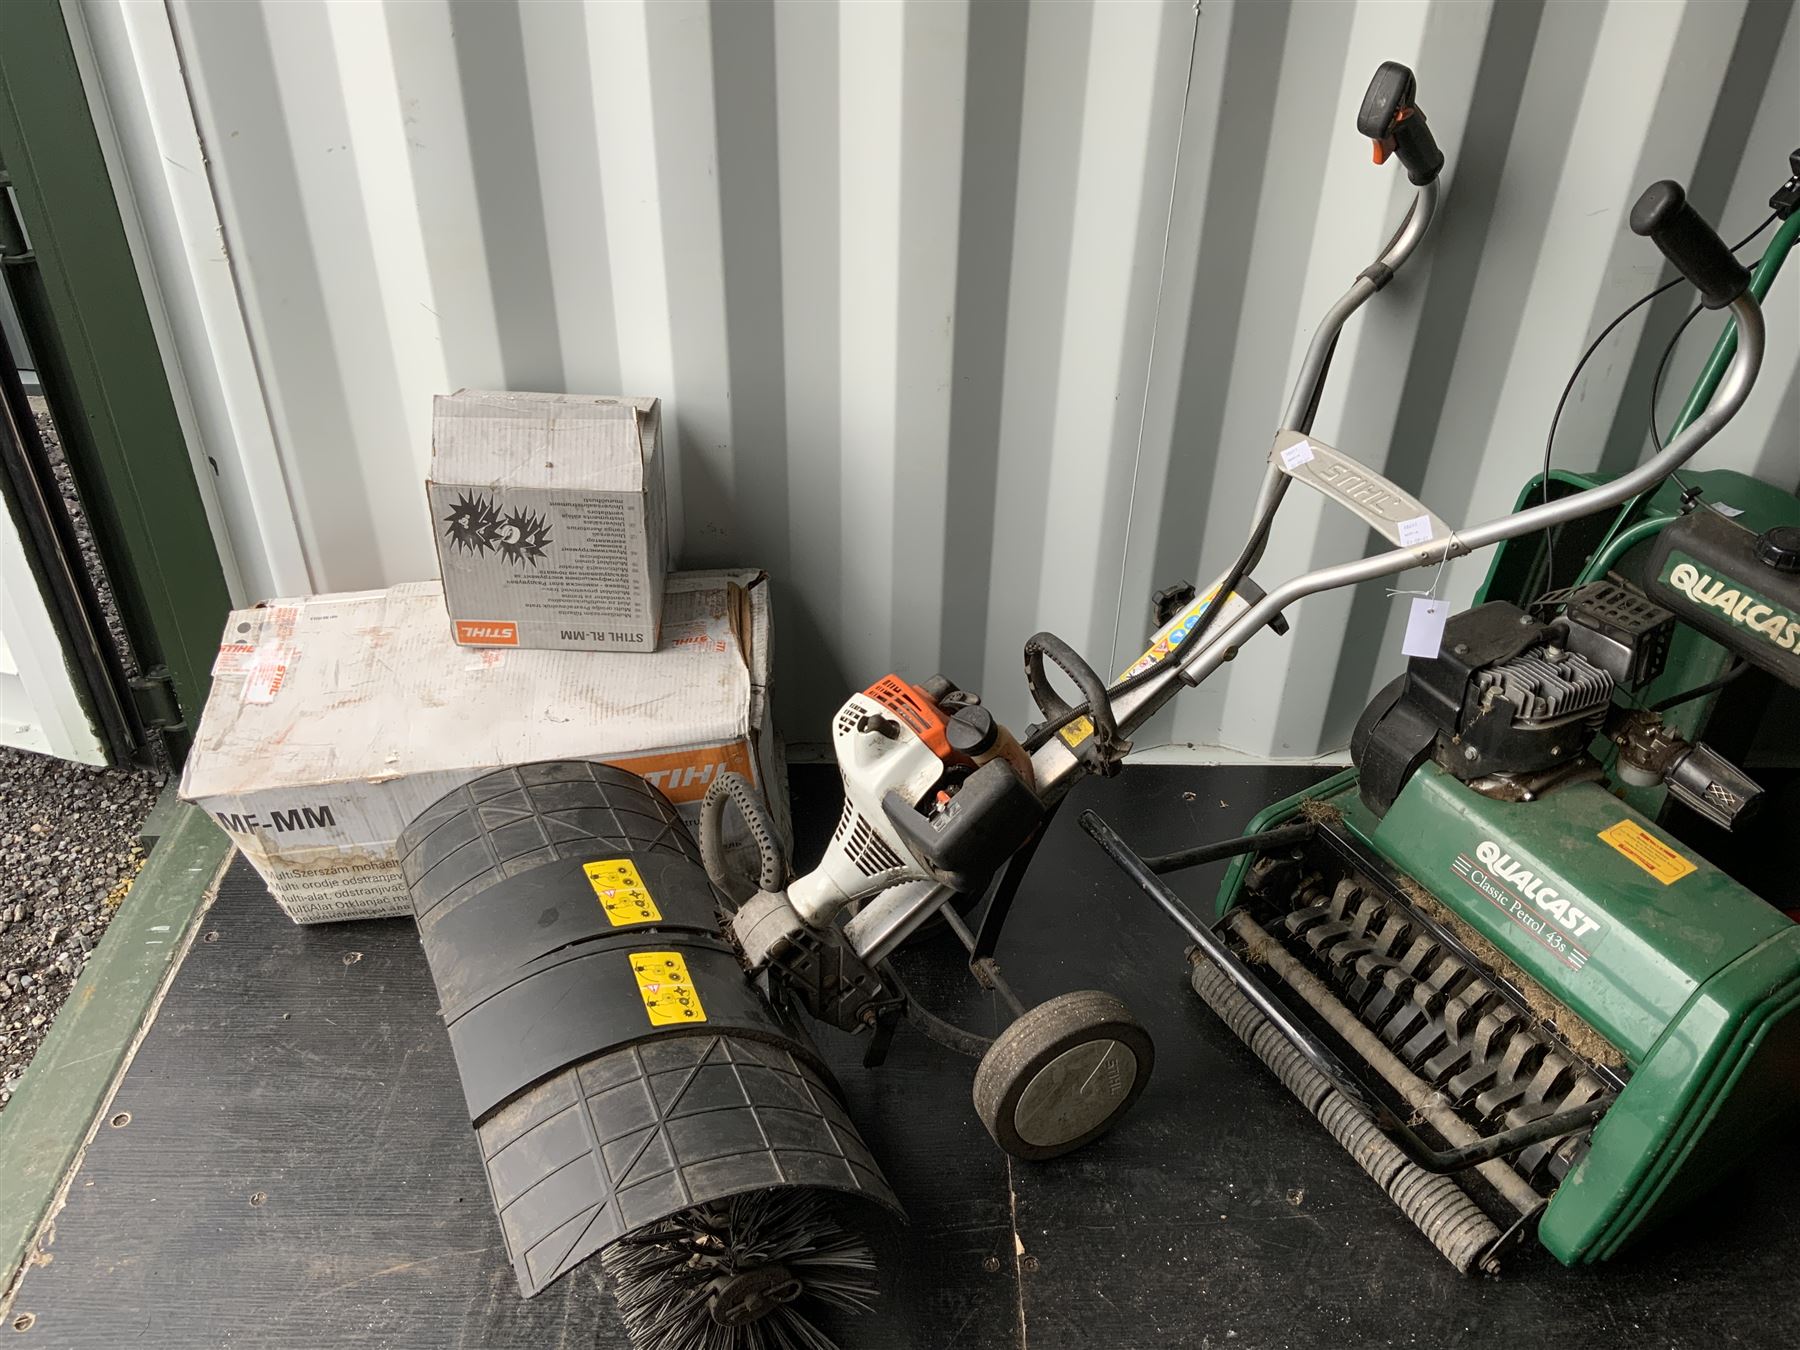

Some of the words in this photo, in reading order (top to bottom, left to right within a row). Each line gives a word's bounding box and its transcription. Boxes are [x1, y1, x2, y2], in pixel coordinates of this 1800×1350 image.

[1320, 462, 1385, 514] STIHL
[461, 626, 514, 639] STIHL
[560, 630, 605, 642] RL-MM
[608, 631, 644, 643] STIHL
[269, 665, 286, 695] STIHL
[640, 762, 728, 789] TIH
[216, 805, 336, 835] MF-MM
[302, 879, 340, 890] orodje
[1476, 841, 1601, 937] QUALCAST
[1470, 870, 1510, 906] Classic
[1509, 900, 1546, 935] Petrol
[1546, 931, 1567, 953] 43s
